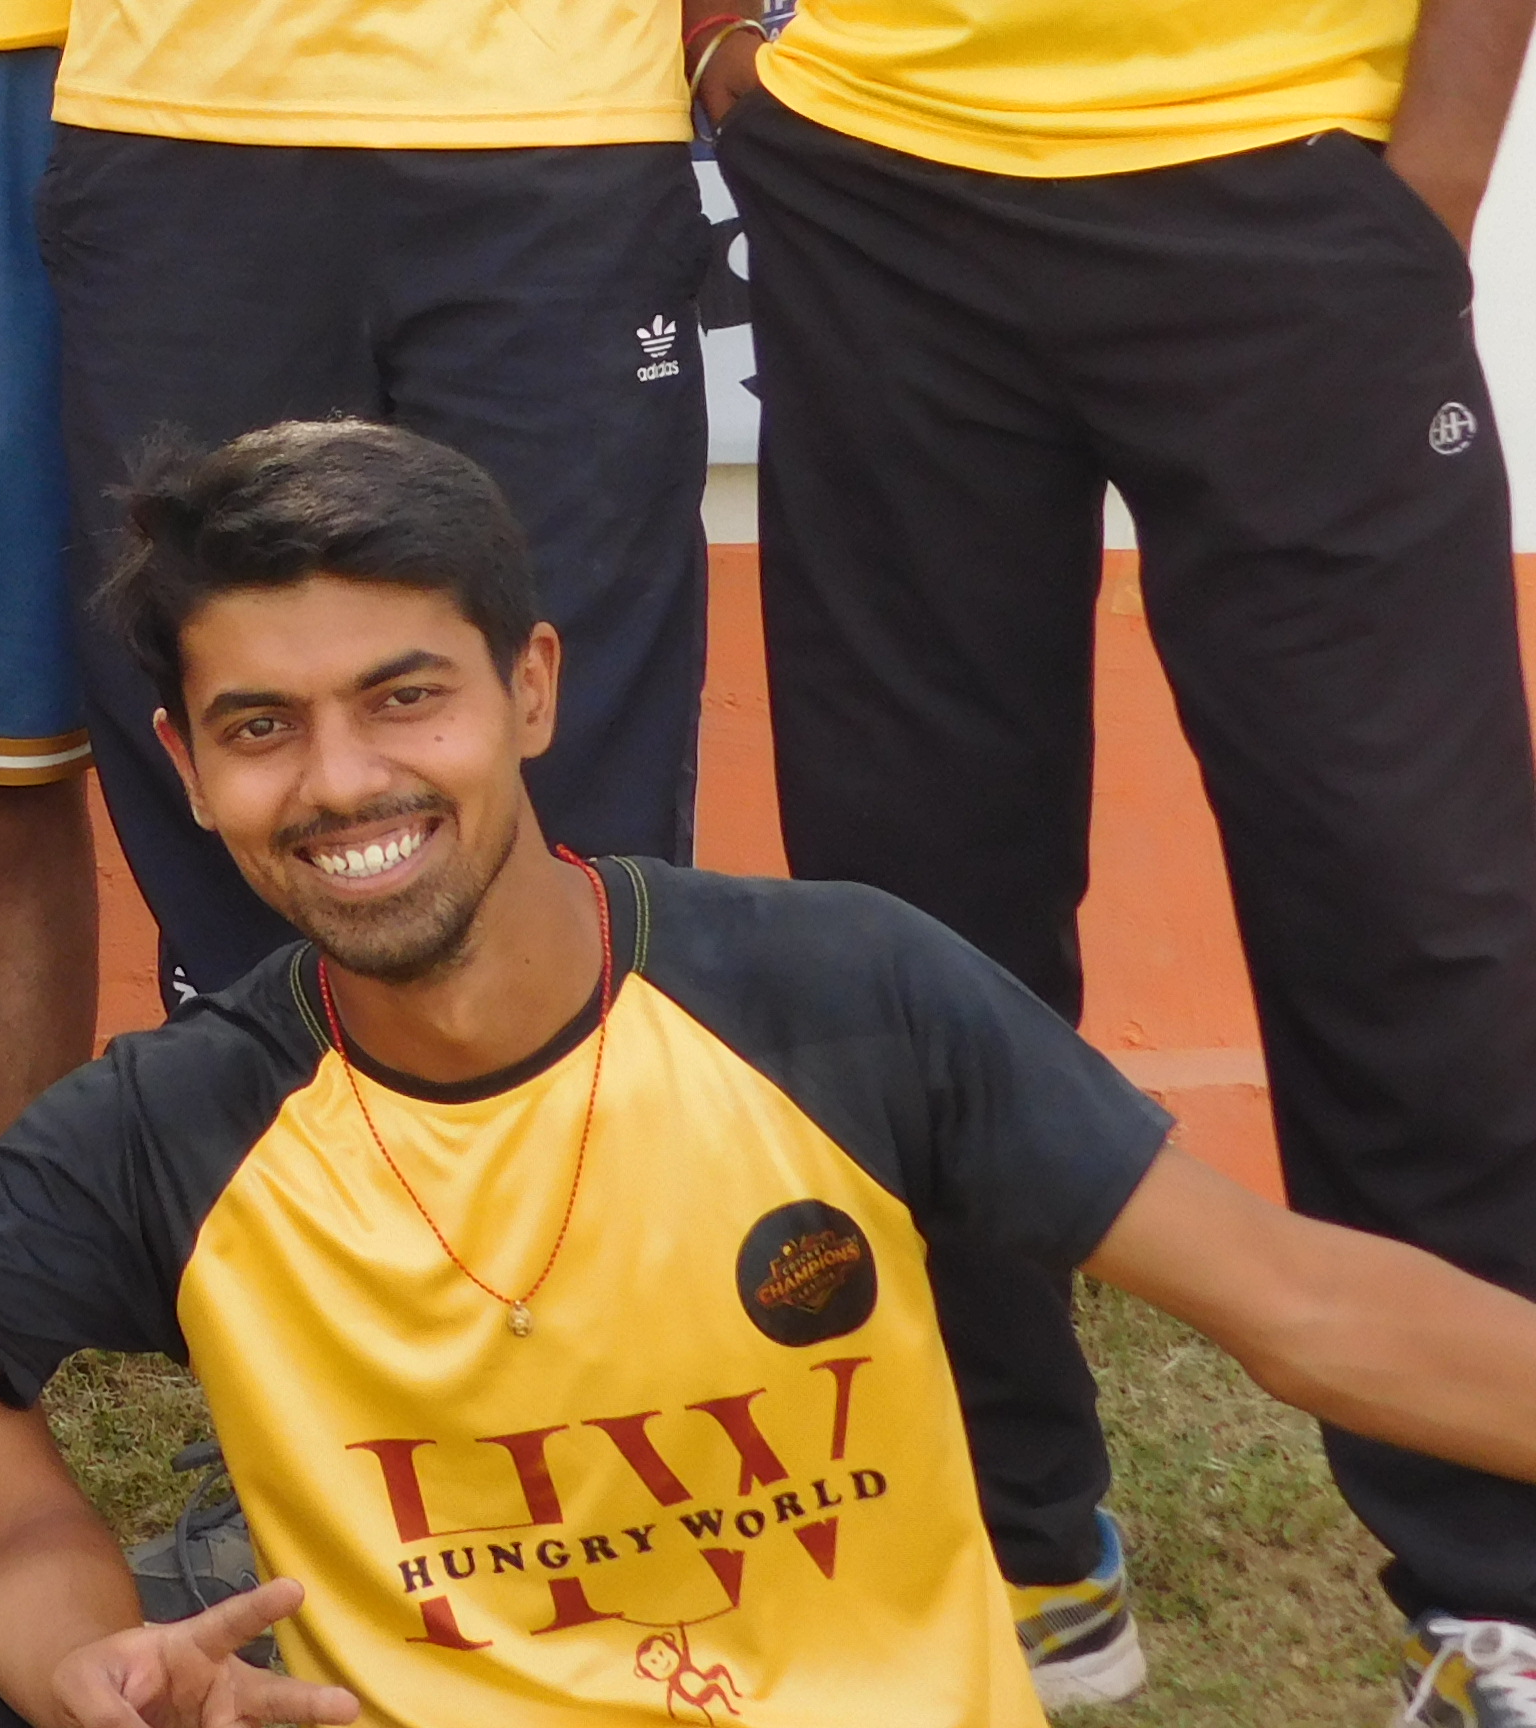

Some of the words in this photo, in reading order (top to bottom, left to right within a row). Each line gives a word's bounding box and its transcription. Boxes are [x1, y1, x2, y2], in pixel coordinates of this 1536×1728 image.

[636, 360, 679, 382] adidas
[759, 1243, 861, 1303] CHAMPIONS
[345, 1356, 872, 1651] HW
[397, 1523, 657, 1594] HUNGRY
[679, 1467, 888, 1541] WORLD
